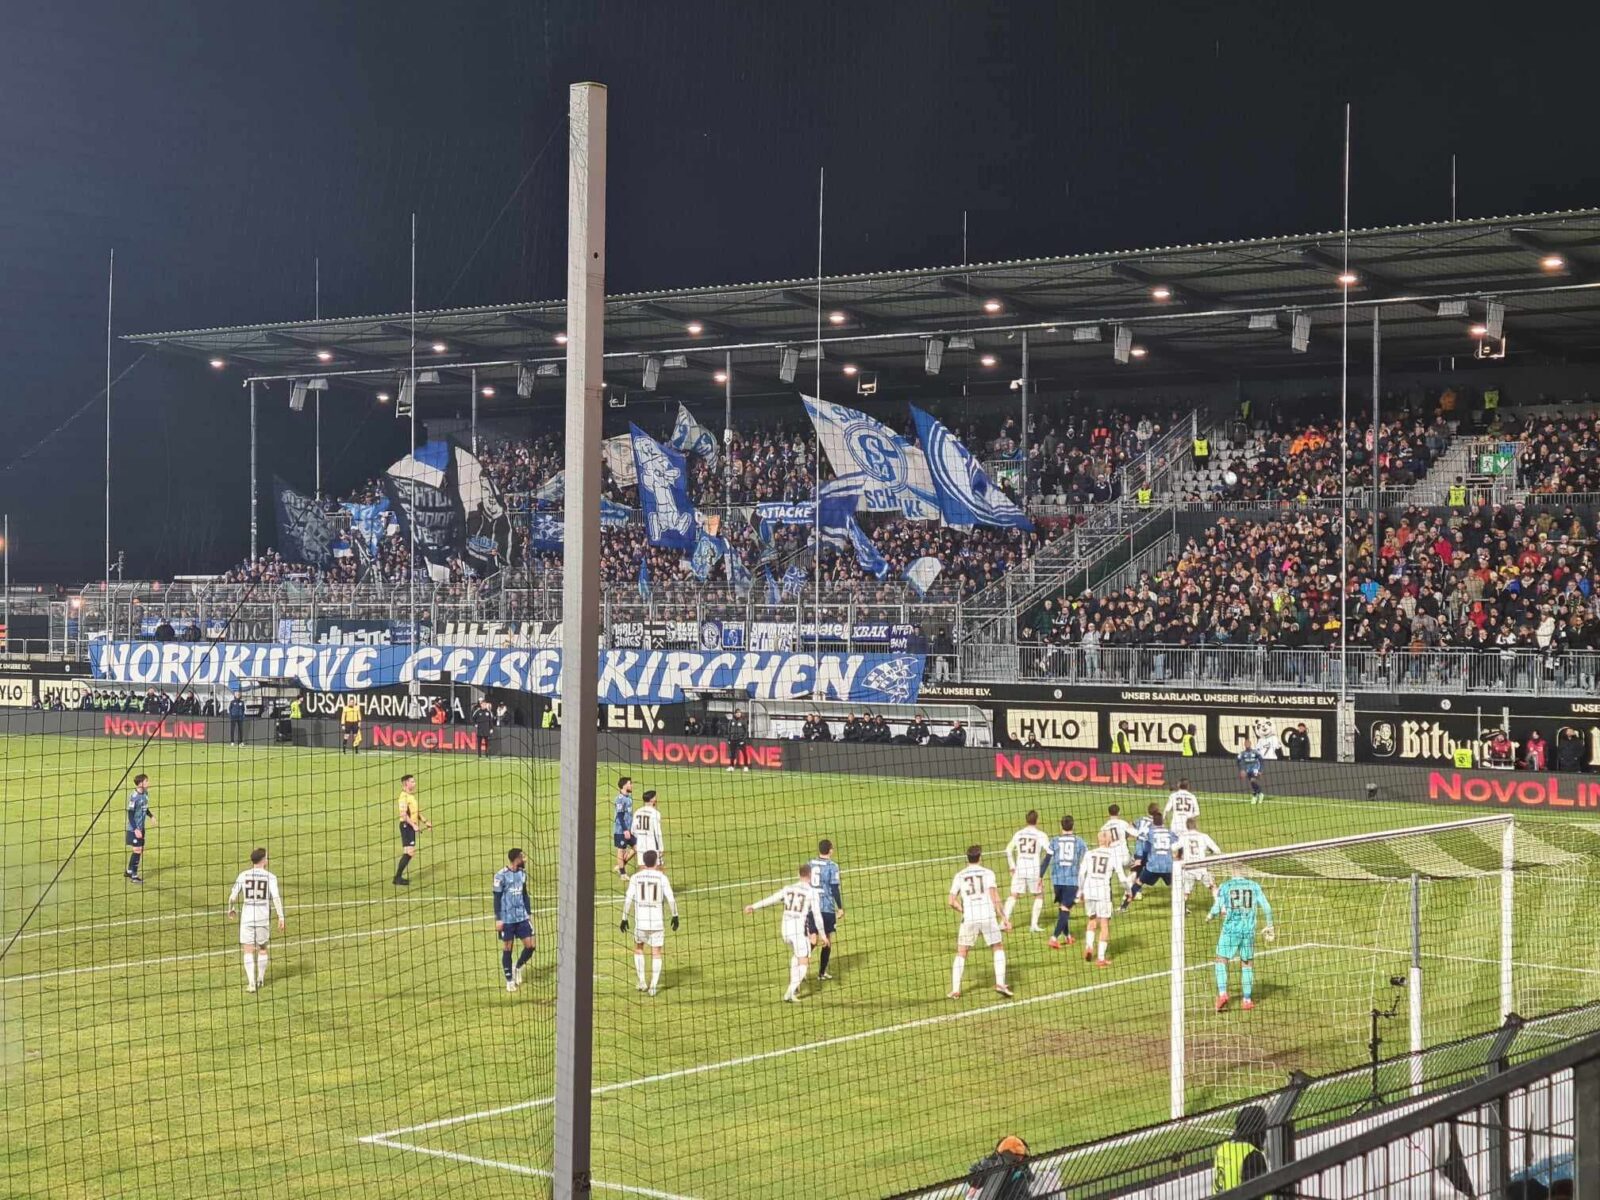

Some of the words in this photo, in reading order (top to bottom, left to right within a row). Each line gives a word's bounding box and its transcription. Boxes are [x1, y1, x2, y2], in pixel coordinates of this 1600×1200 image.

[99, 643, 378, 691] NORDKURVE
[943, 688, 975, 696] UNSERE
[976, 689, 991, 697] ELV.
[1122, 692, 1150, 700] UNSER
[1203, 694, 1239, 703] UNSERE
[1278, 696, 1316, 705] UNSERE
[1317, 697, 1336, 705] ELV.
[608, 704, 664, 733] ELV.
[1020, 718, 1080, 739] HYLO
[1127, 722, 1186, 743] HYLO
[1175, 797, 1192, 812] 25
[636, 814, 650, 831] 30
[1019, 837, 1036, 855] 23
[1058, 841, 1075, 860] 19
[1092, 855, 1109, 875] 19
[245, 879, 268, 899] 29
[964, 875, 985, 896] 31
[786, 891, 806, 913] 33
[1230, 889, 1252, 909] 20
